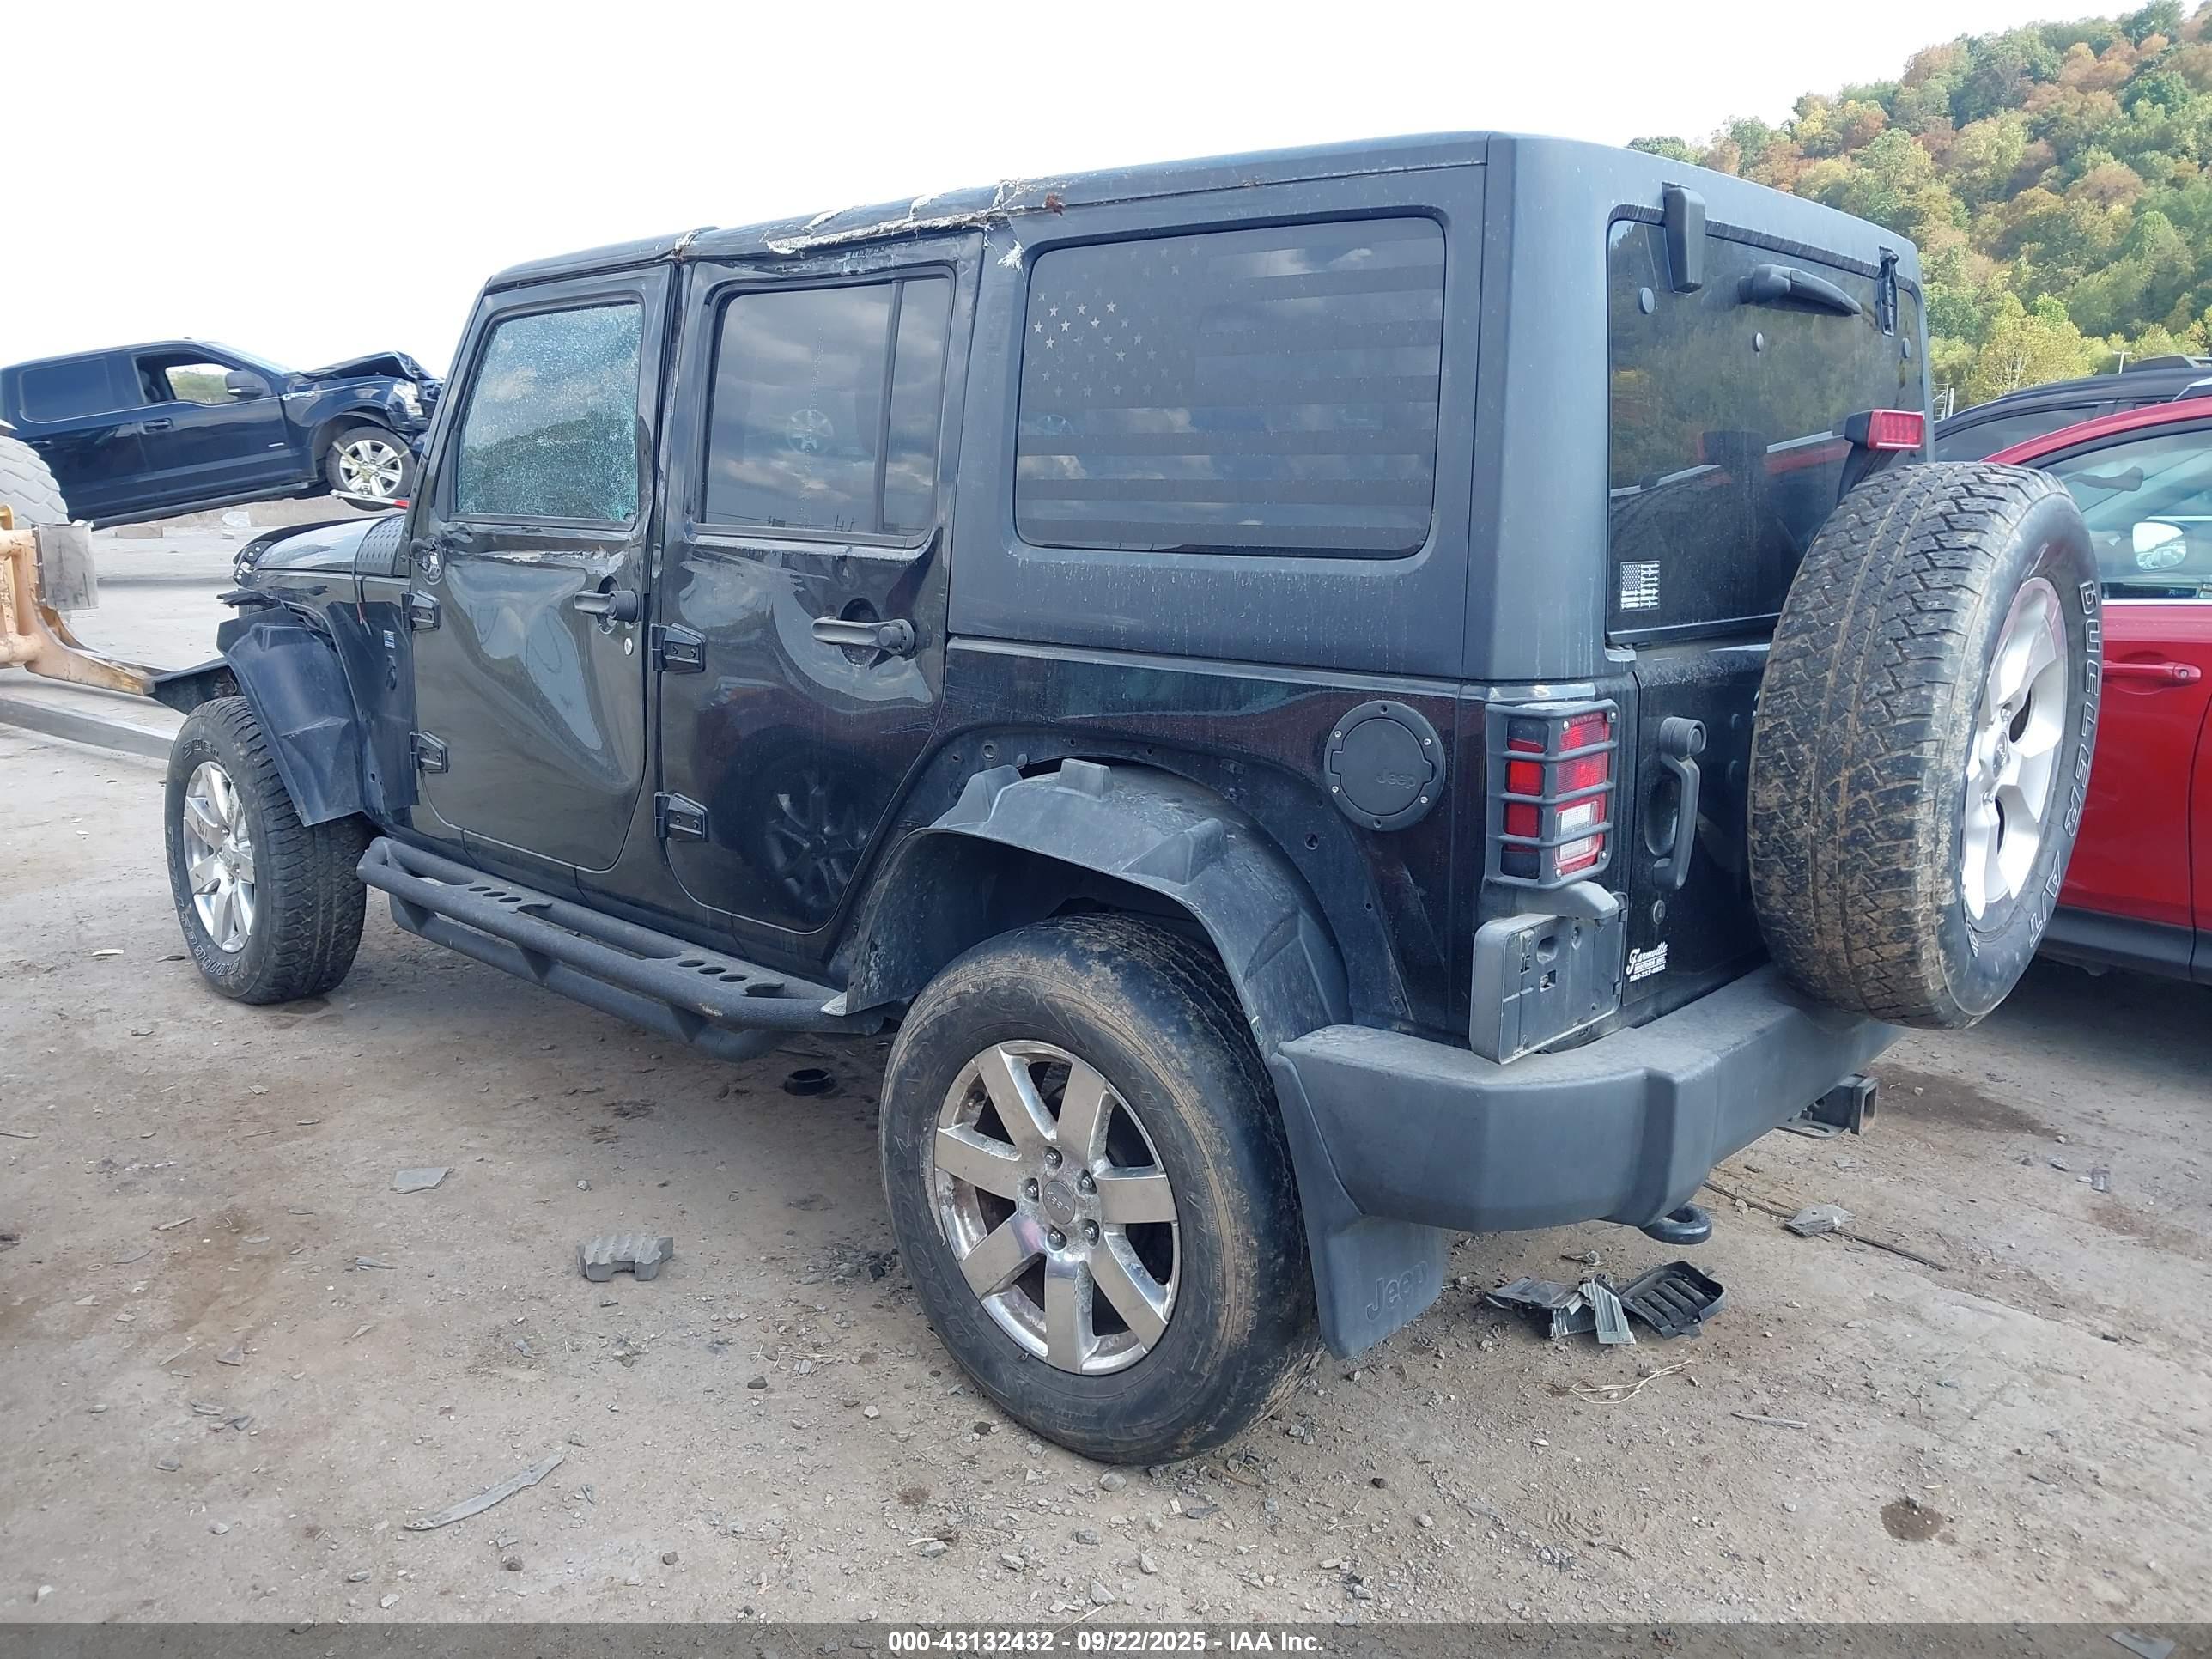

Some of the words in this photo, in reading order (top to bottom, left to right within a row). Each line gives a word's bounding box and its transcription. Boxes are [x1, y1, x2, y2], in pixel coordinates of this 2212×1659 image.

[2063, 580, 2101, 837] DUELER
[1376, 768, 1417, 790] Jeep
[2029, 849, 2061, 949] A/T
[1365, 1260, 1429, 1322] Jeep
